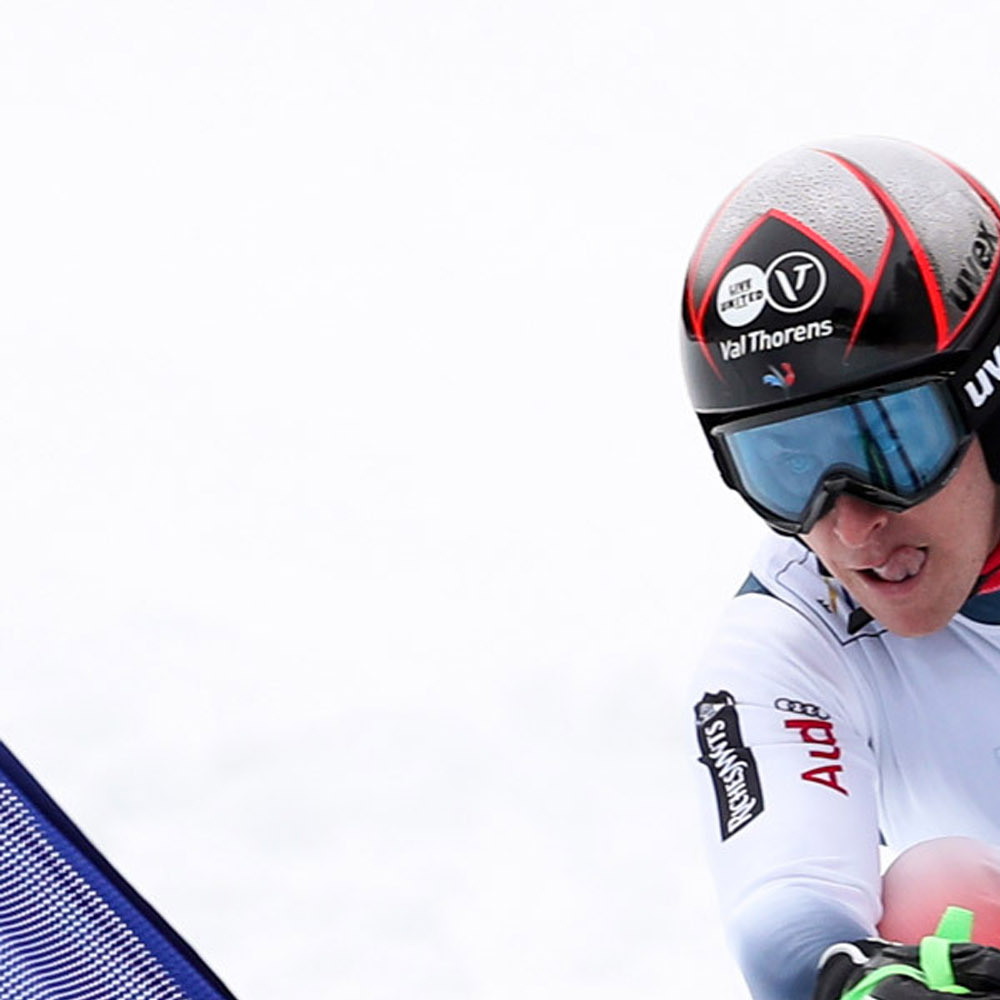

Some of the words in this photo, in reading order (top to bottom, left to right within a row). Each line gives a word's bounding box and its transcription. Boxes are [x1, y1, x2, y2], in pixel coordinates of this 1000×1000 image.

[950, 221, 996, 312] uvex
[720, 289, 764, 312] UNITED
[720, 334, 746, 361] Val
[747, 319, 834, 352] Thorens
